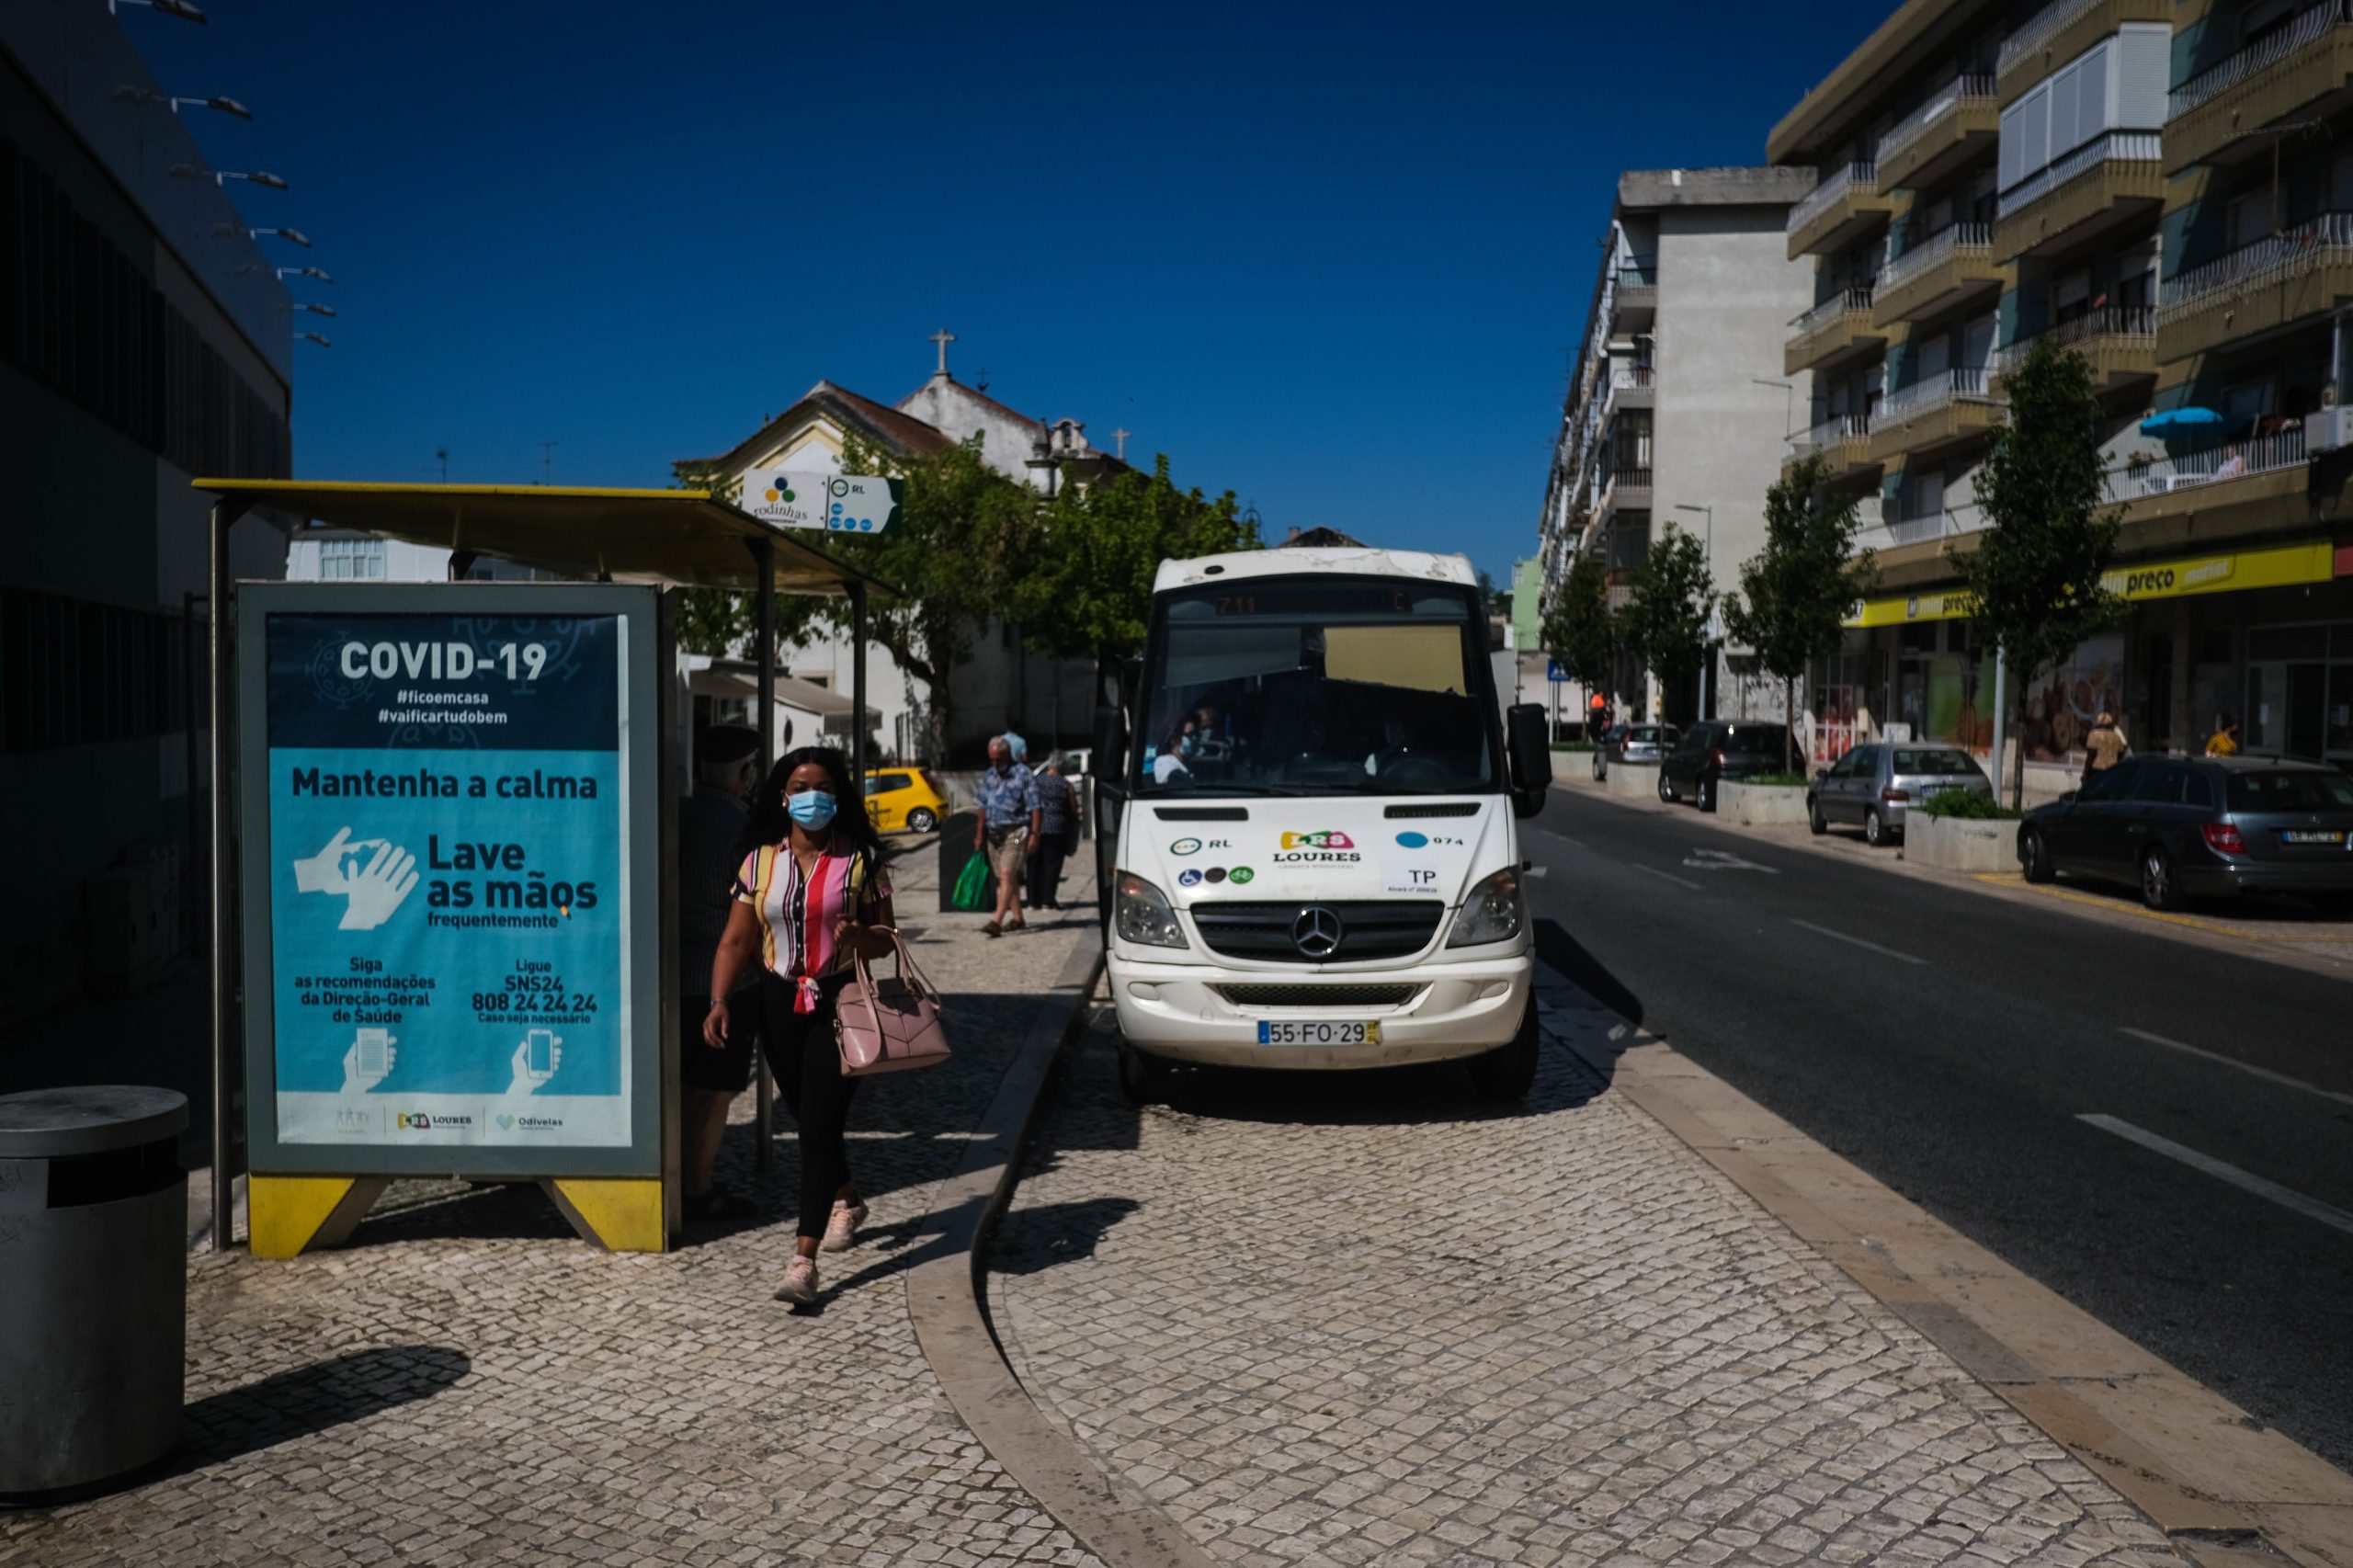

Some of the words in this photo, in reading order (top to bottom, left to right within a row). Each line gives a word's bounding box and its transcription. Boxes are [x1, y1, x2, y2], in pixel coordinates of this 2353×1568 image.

[851, 484, 866, 494] RL
[754, 502, 808, 521] rodinhas
[340, 641, 548, 681] COVID-19
[397, 688, 490, 706] #ficoemcasa
[378, 709, 508, 725] #vaificartudobem
[291, 767, 459, 799] Mantenha
[467, 776, 487, 799] a
[495, 769, 598, 800] calma
[428, 834, 526, 870] Lave
[1209, 839, 1232, 848] RL
[1272, 852, 1361, 863] LOURES
[1408, 869, 1436, 883] TP
[427, 880, 474, 908] as
[485, 870, 598, 910] mãos
[427, 912, 559, 930] frequentemente
[349, 956, 383, 974] Siga
[516, 959, 552, 974] Ligue
[295, 976, 312, 988] as
[315, 973, 436, 992] recomendações
[506, 974, 564, 993] SNS24
[301, 991, 320, 1006] da
[323, 990, 430, 1009] Direção-Geral
[472, 992, 510, 1012] 808
[515, 994, 539, 1013] 24
[543, 994, 568, 1013] 24
[573, 994, 597, 1013] 24
[333, 1009, 351, 1023] de
[354, 1007, 403, 1024] Saúde
[478, 1013, 505, 1023] Caso
[506, 1013, 529, 1025] seja
[531, 1013, 591, 1025] necessário
[432, 1115, 472, 1125] LOURES
[517, 1116, 564, 1127] Odivelas
